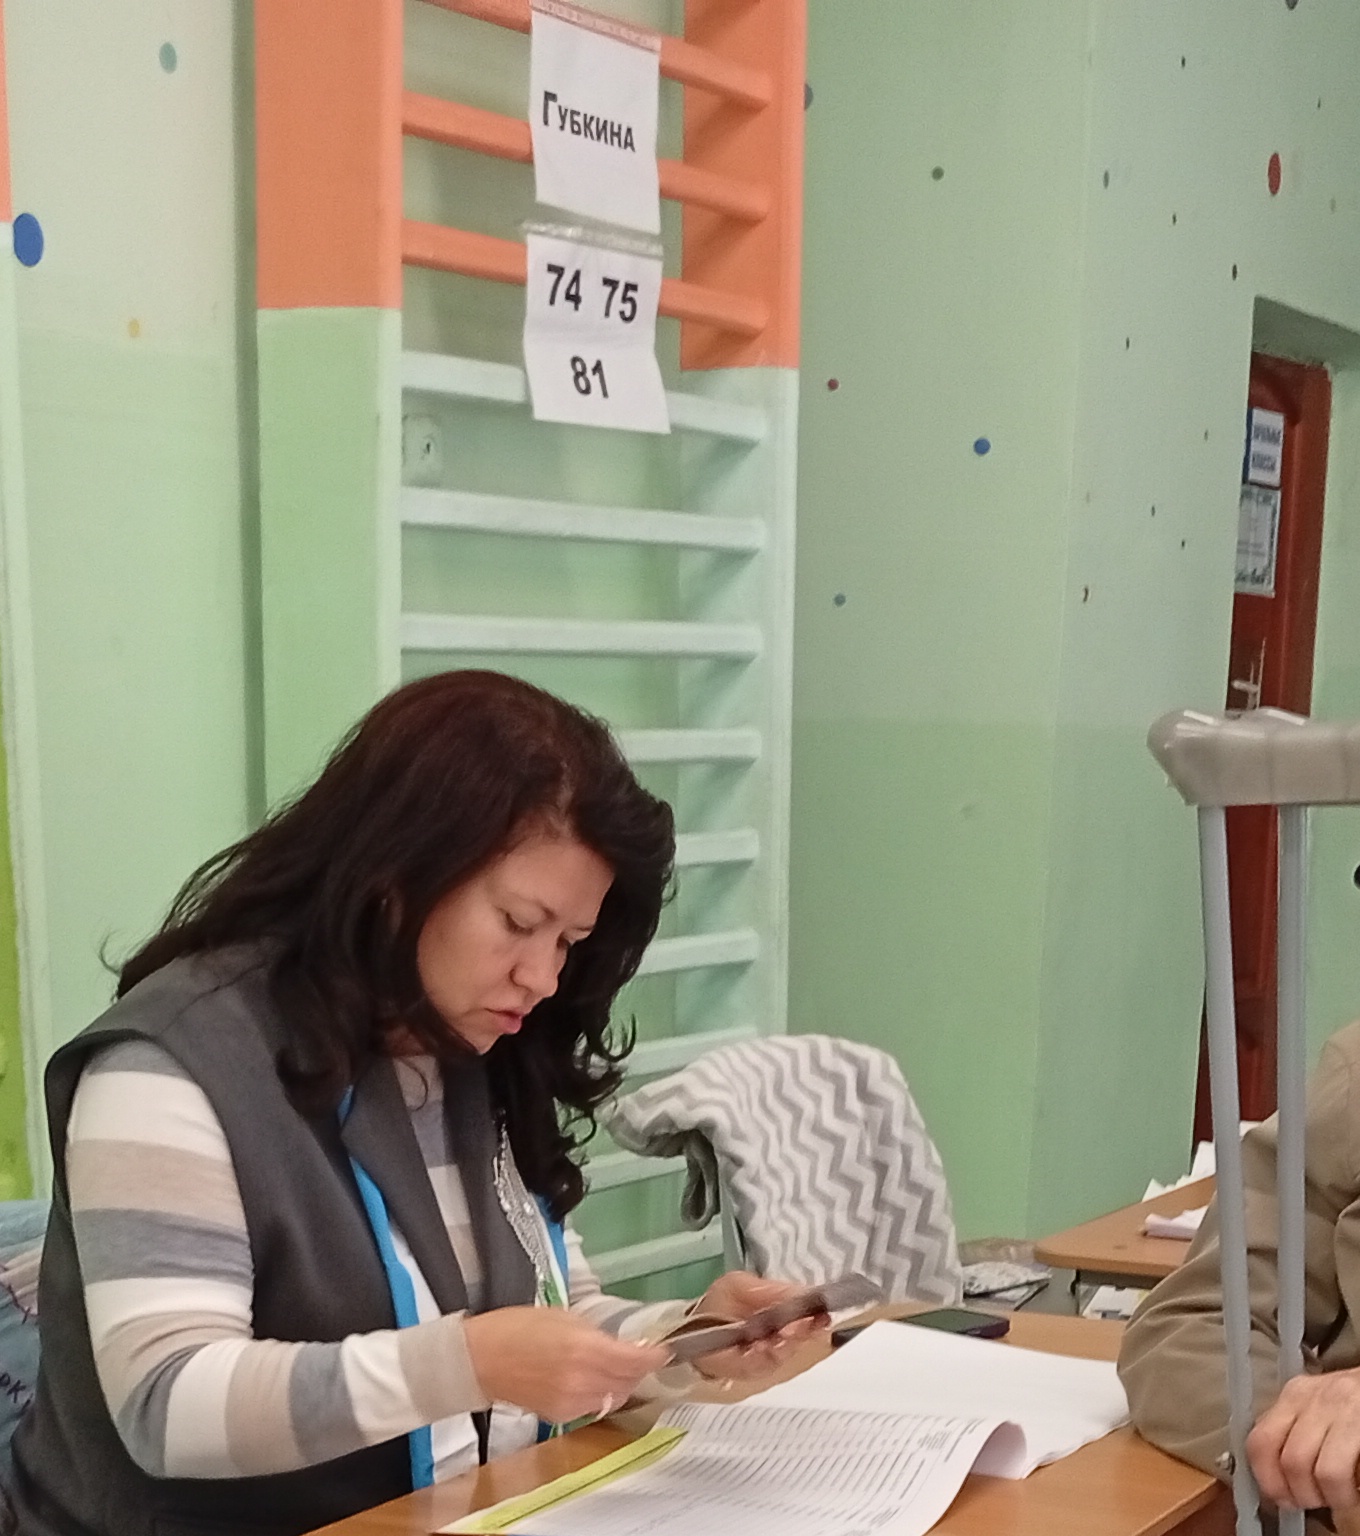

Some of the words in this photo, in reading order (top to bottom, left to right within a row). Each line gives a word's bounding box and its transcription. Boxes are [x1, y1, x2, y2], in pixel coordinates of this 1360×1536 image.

[546, 263, 583, 312] 74
[601, 276, 639, 324] 75
[570, 355, 609, 399] 81
